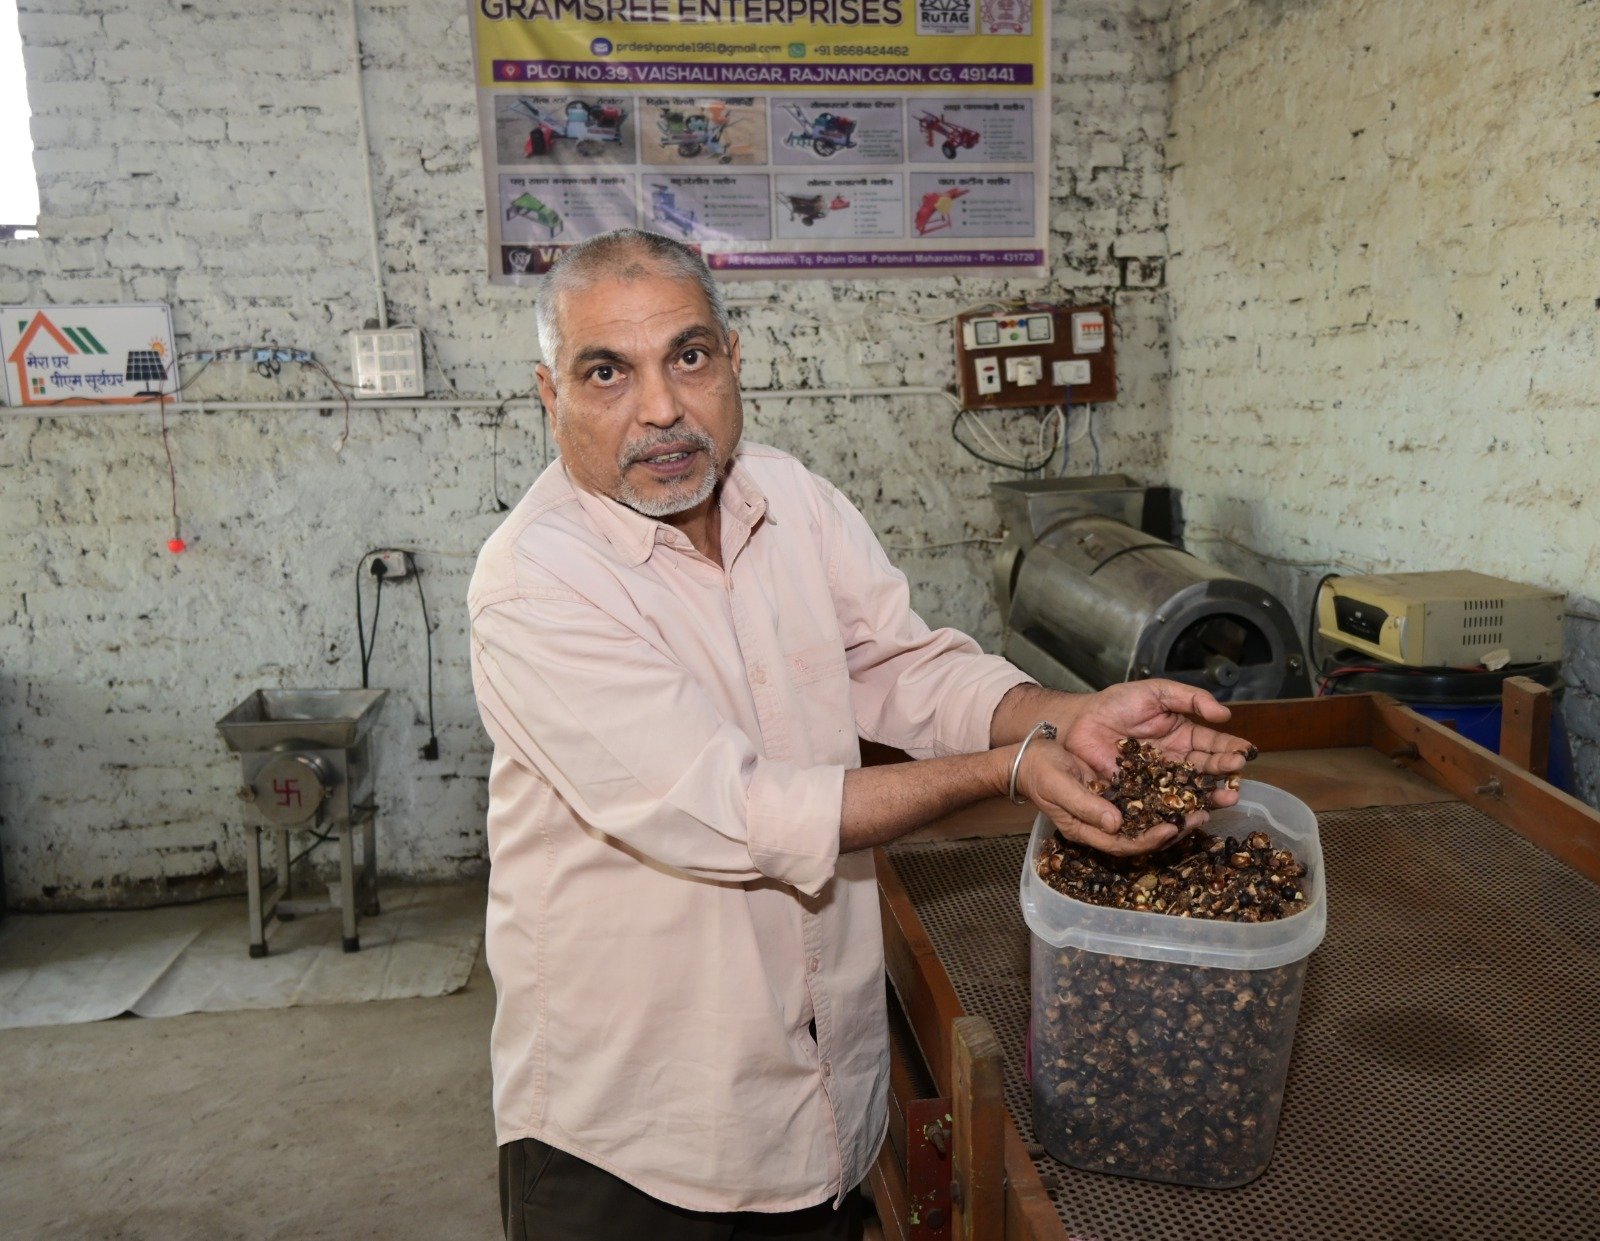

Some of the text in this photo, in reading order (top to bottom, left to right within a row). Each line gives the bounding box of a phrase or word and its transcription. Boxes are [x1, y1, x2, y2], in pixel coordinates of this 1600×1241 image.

[480, 0, 903, 24] GRAMSREE ENTERPRISES
[526, 64, 1015, 83] PLOT NO.39, VAISHALI NAGAR, RAJNANDGAON, CG, 491441
[816, 254, 847, 265] Palam
[871, 254, 913, 264] Parbhani
[915, 254, 972, 263] Maharashtra
[26, 352, 69, 369] मेरा घर
[50, 369, 124, 393] पीएम सूर्यघर
